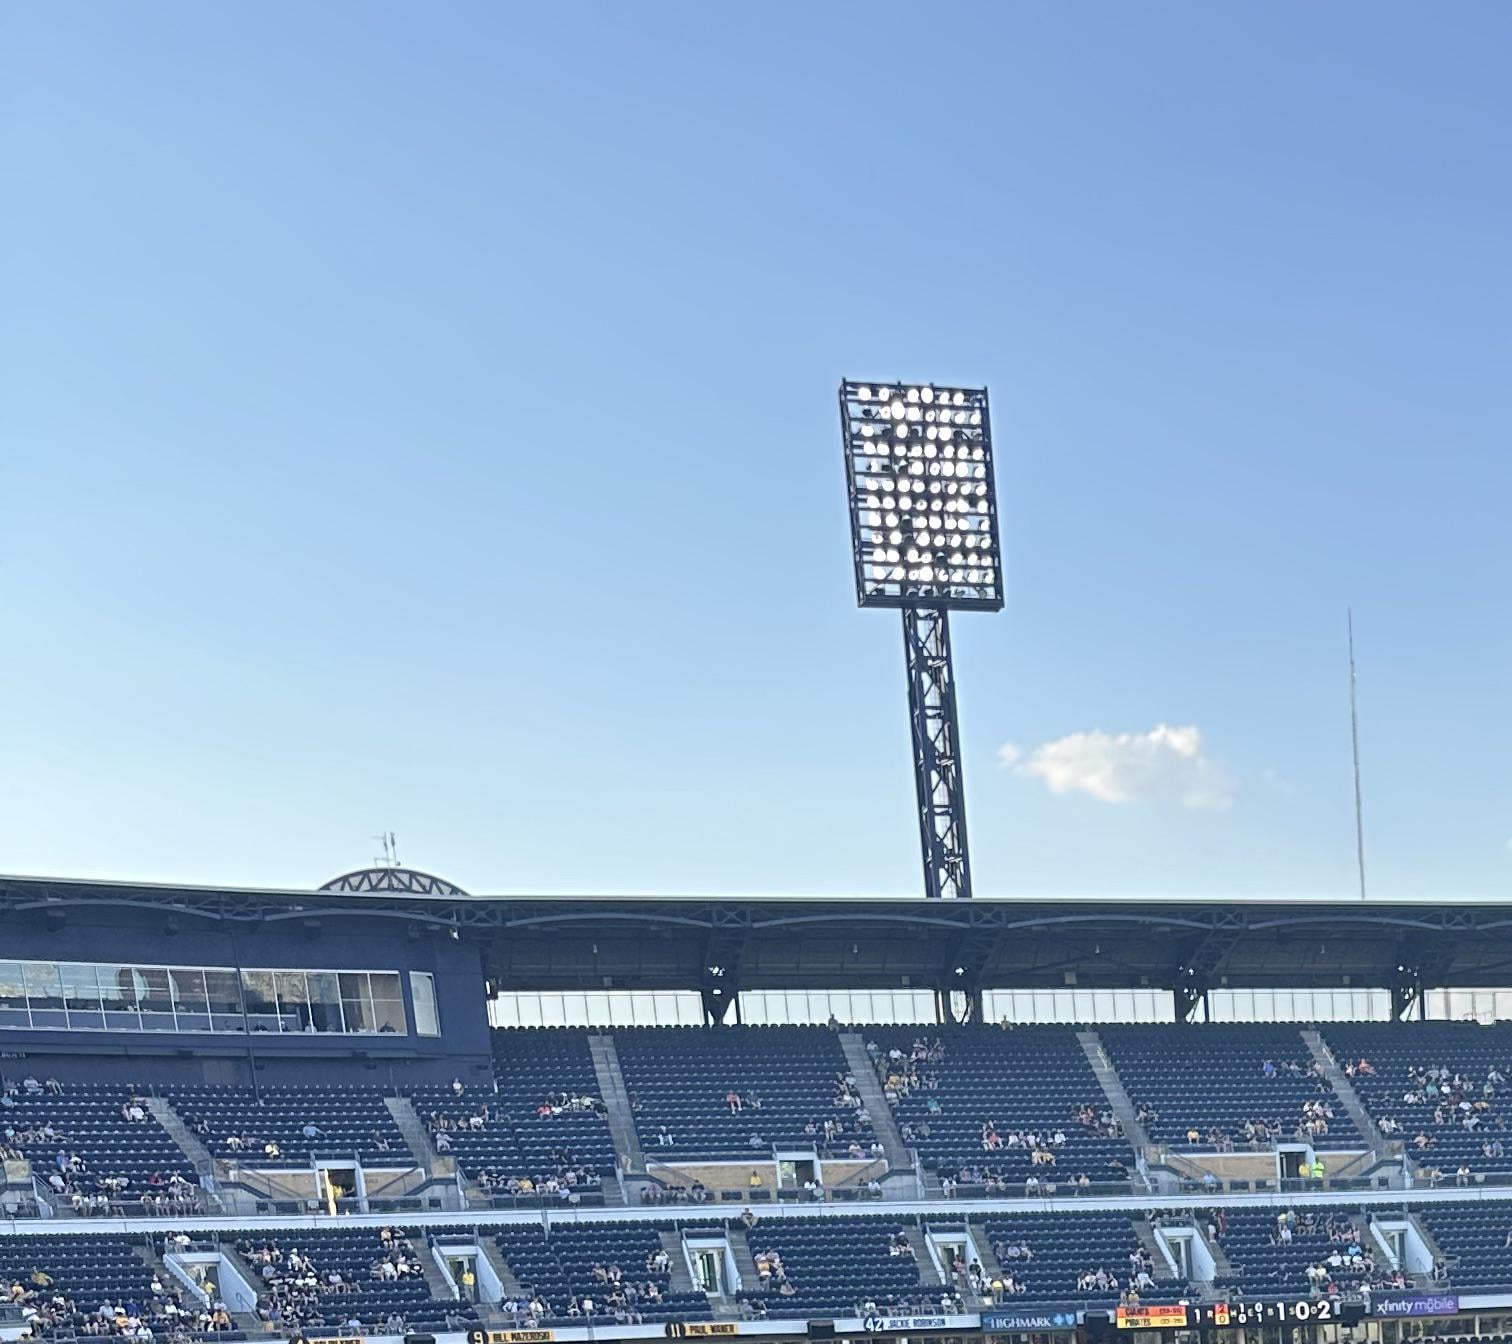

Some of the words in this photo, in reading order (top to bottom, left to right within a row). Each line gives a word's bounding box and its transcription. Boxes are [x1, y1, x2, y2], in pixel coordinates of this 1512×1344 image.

[1277, 1302, 1285, 1321] 1
[1295, 1301, 1310, 1320] 0
[1317, 1300, 1331, 1320] 2
[1377, 1299, 1413, 1315] xfinity
[1414, 1298, 1455, 1313] mobile
[671, 1323, 681, 1338] 11
[865, 1318, 883, 1332] 42
[990, 1317, 1052, 1329] HIGHMARK
